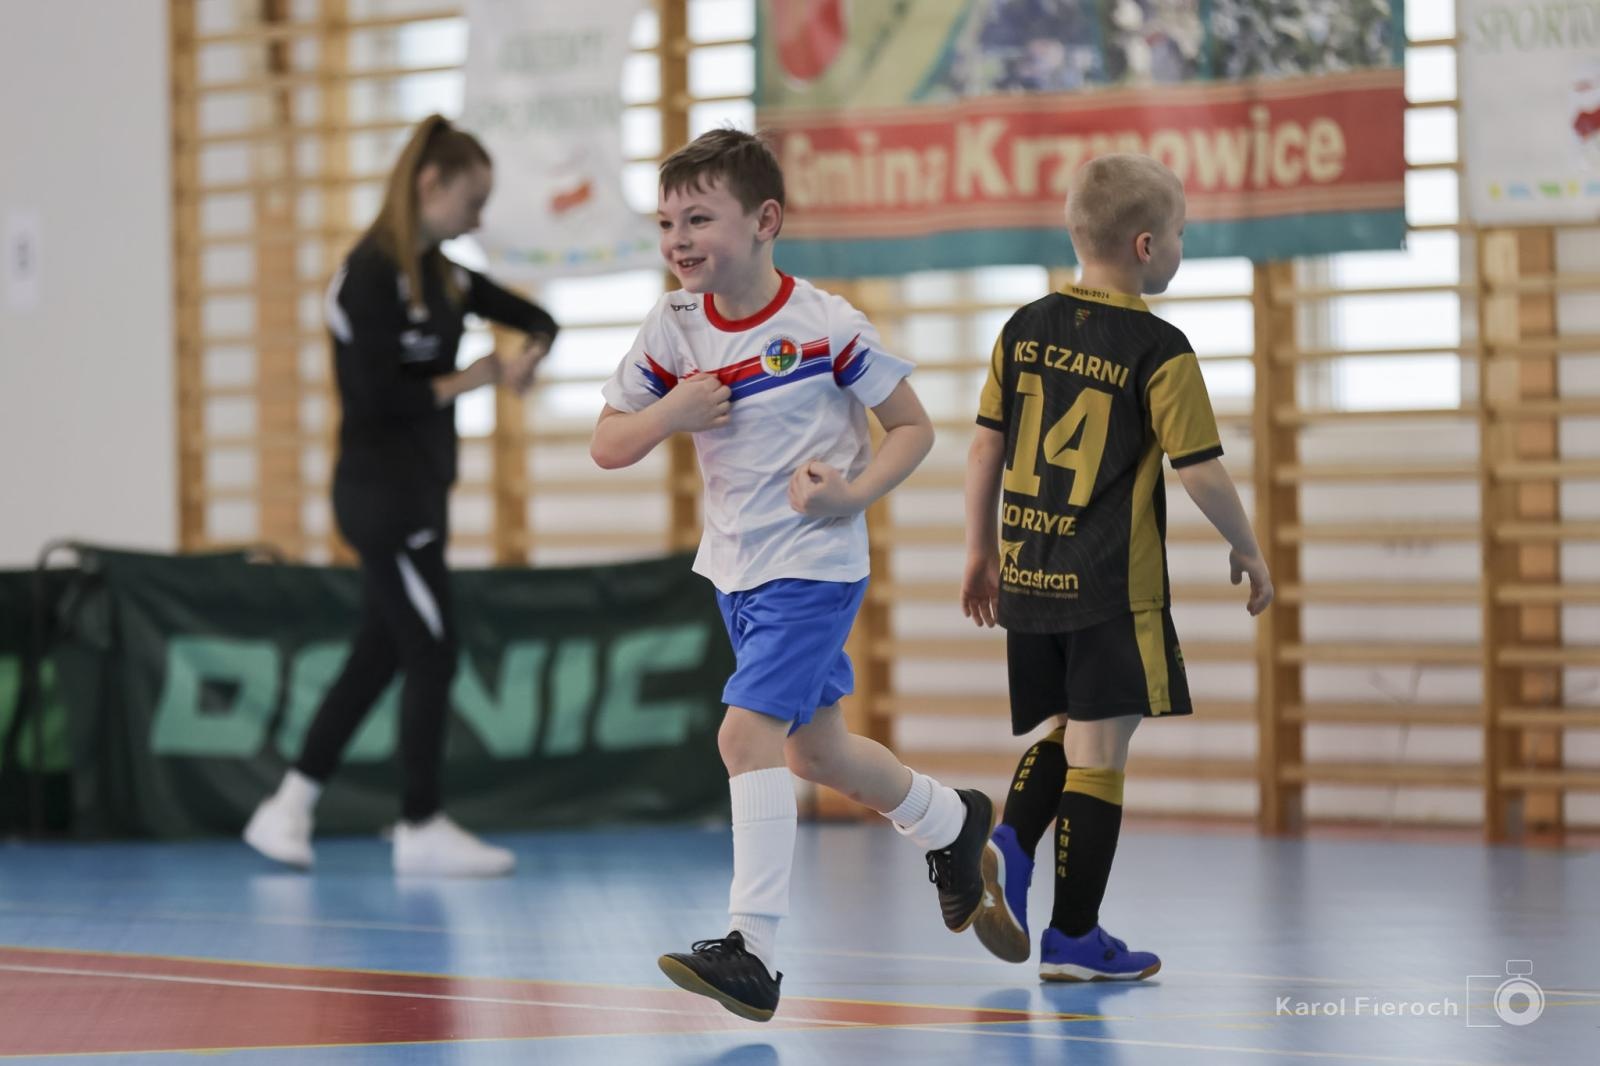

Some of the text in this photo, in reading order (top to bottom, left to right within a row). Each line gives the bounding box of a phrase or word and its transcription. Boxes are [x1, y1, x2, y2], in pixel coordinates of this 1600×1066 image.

[955, 105, 1346, 198] Krzowice
[1014, 340, 1129, 388] KS CZARNI
[1003, 371, 1113, 508] 14
[1014, 745, 1039, 792] 1924
[1057, 818, 1070, 878] 1924
